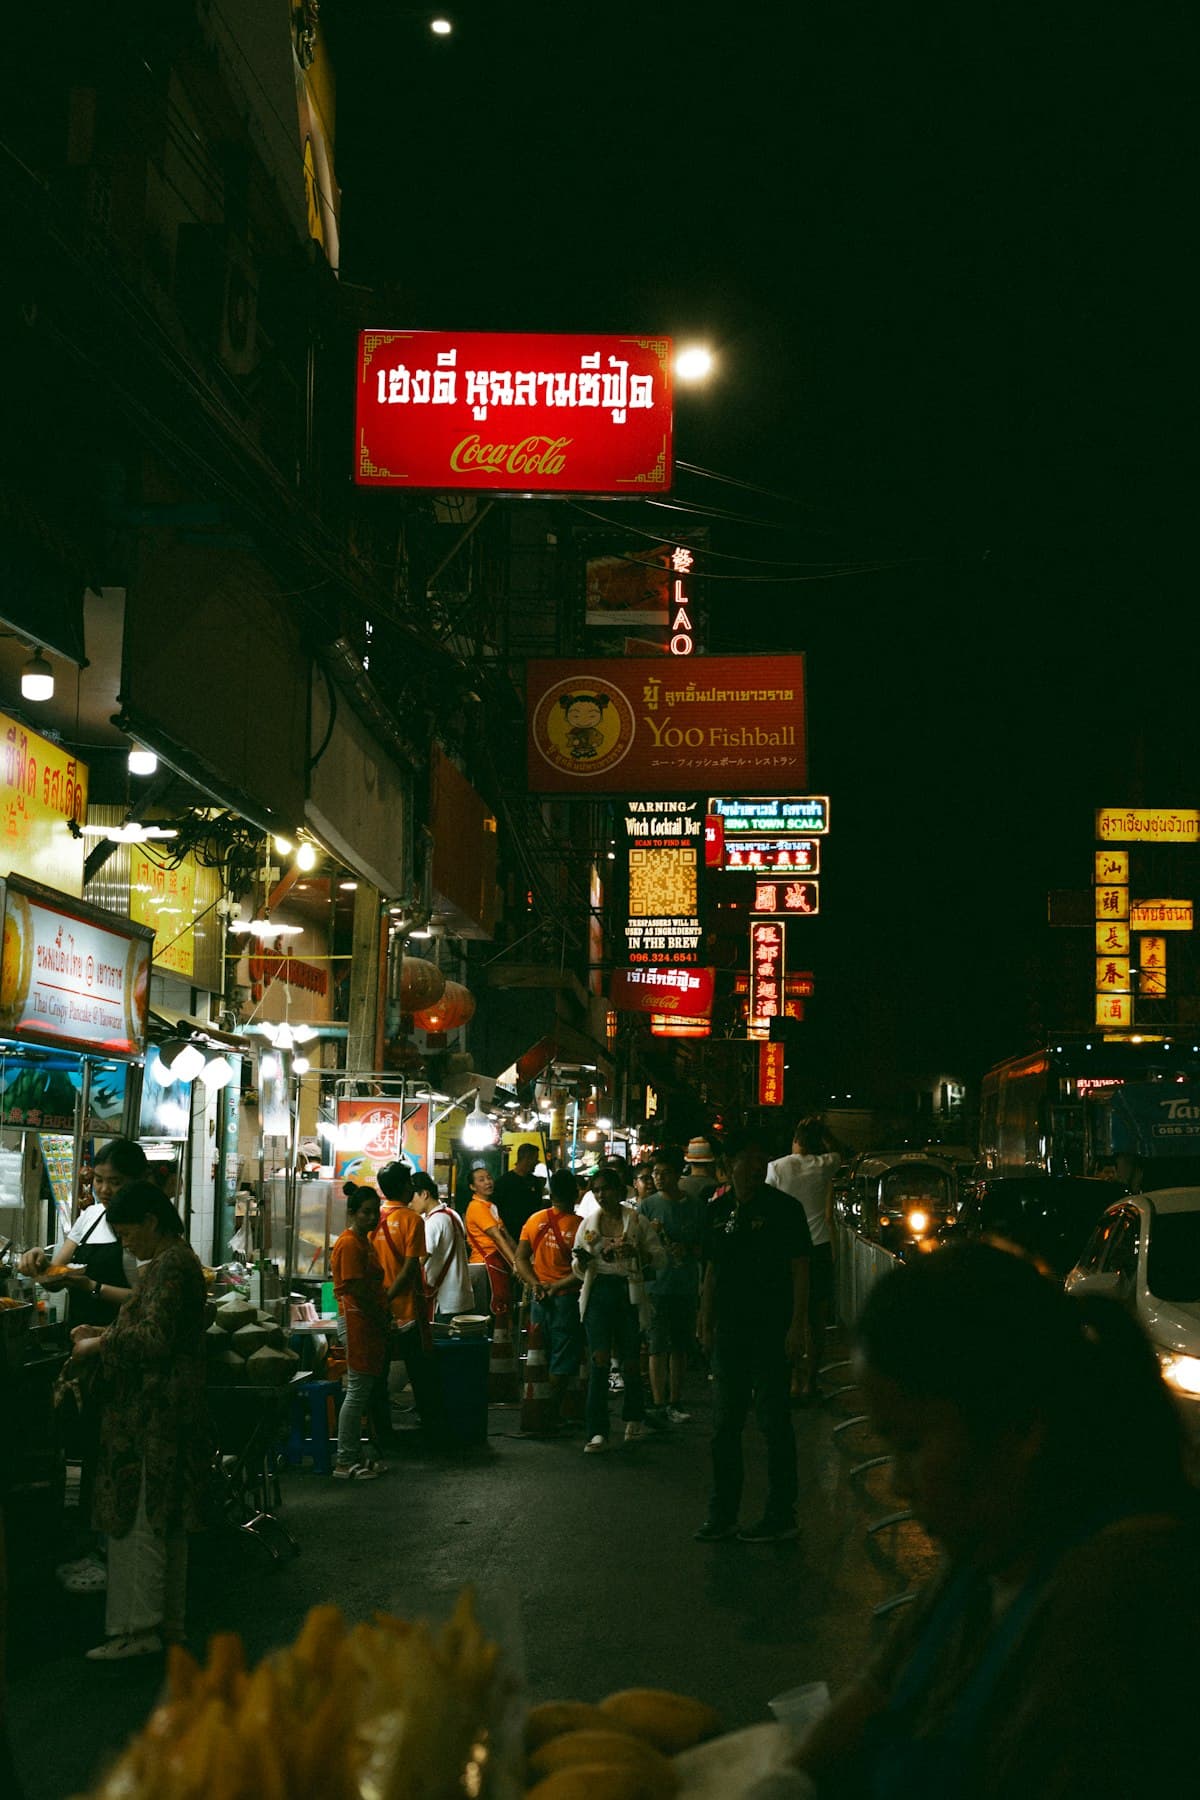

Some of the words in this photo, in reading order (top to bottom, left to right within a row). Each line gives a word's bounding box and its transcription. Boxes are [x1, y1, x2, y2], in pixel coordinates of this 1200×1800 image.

[377, 349, 457, 405] เฮงดี
[465, 351, 655, 425] หูฉลามซีฟู้ด
[450, 434, 574, 475] Coca-Cola
[709, 726, 796, 747] Fishball
[628, 801, 687, 813] WARNING
[624, 816, 649, 836] Witch
[650, 816, 682, 836] Cocktail
[683, 816, 702, 836] Bar
[751, 818, 785, 829] TOWN
[787, 818, 824, 829] SCALA
[653, 839, 663, 847] TO
[672, 918, 689, 927] WILL
[689, 918, 699, 927] BE
[624, 927, 643, 936] USED
[644, 927, 653, 936] AS
[654, 926, 703, 936] INGREDIENTS
[628, 936, 641, 949] IN
[642, 936, 665, 949] THE
[667, 936, 699, 949] BREW
[1103, 858, 1125, 1020] 汕頭長春酒
[629, 952, 698, 963] 096.324.6541
